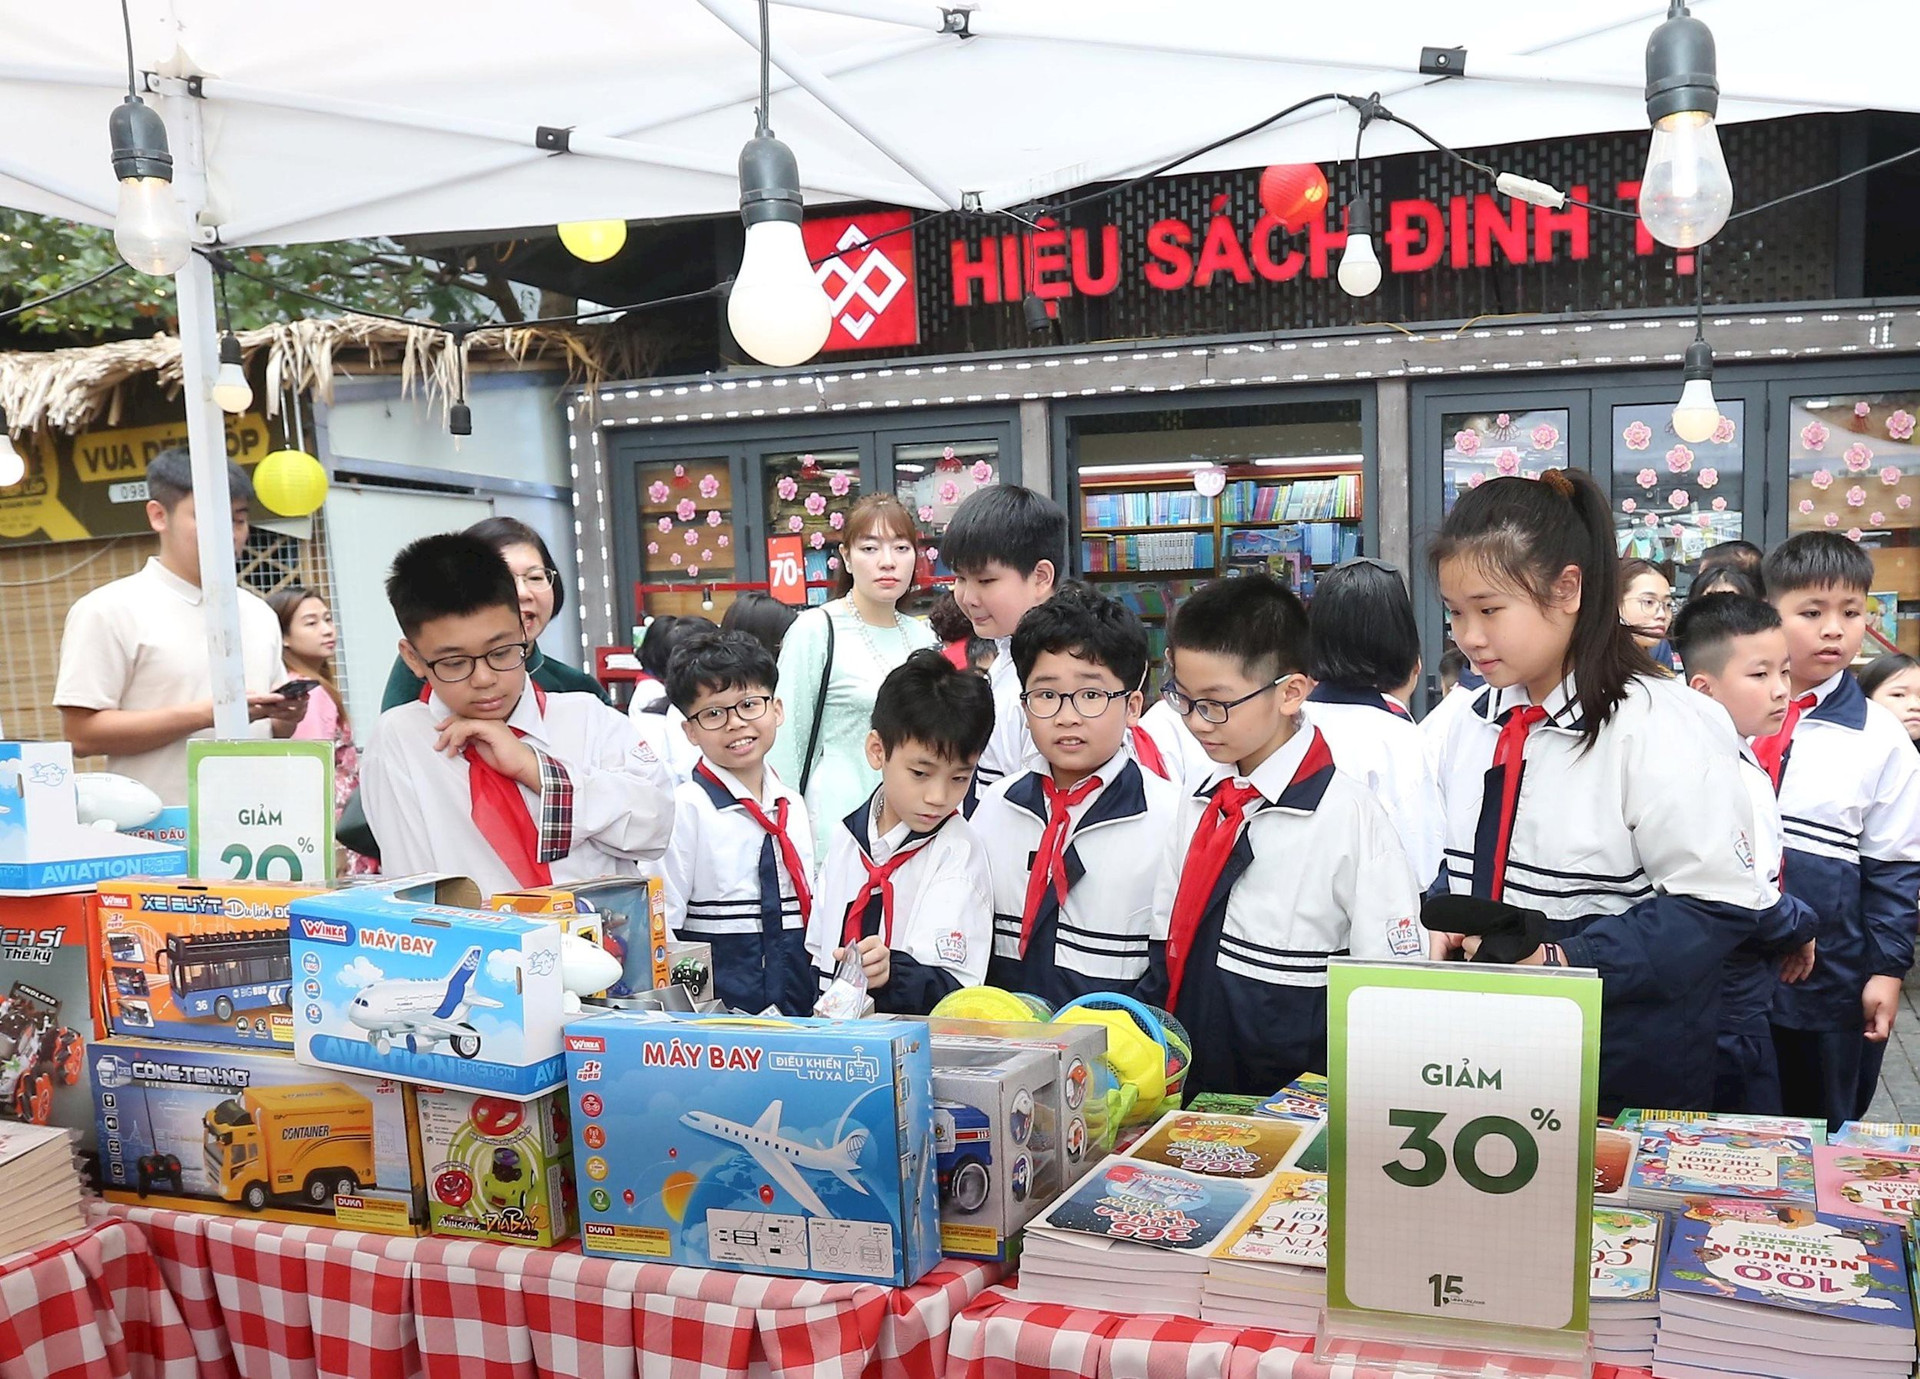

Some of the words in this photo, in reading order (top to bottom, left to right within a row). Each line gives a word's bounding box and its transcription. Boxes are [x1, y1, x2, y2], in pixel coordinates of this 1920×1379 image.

[951, 216, 1119, 318] HIỆU
[1144, 194, 1350, 291] SÁCH
[1385, 185, 1590, 273] ĐINH
[83, 443, 137, 473] VUA
[238, 803, 282, 826] GIẢM
[42, 858, 141, 885] AVIATION
[142, 895, 167, 911] XE
[171, 894, 223, 913] BUÝT
[361, 928, 397, 948] MÁY
[400, 936, 434, 955] BAY
[5, 948, 32, 960] Thế
[19, 984, 57, 1005] ENDLESS
[195, 1000, 208, 1011] 36
[644, 1039, 702, 1068] MÁY
[709, 1046, 762, 1071] BAY
[577, 1072, 599, 1081] ages
[584, 1062, 600, 1072] 3+
[826, 1071, 843, 1082] XA
[1421, 1058, 1502, 1091] GIẢM
[282, 1125, 330, 1140] CONTAINER
[1107, 1222, 1193, 1241] 365
[1800, 1255, 1858, 1271] NGỤ
[1734, 1264, 1844, 1294] 100
